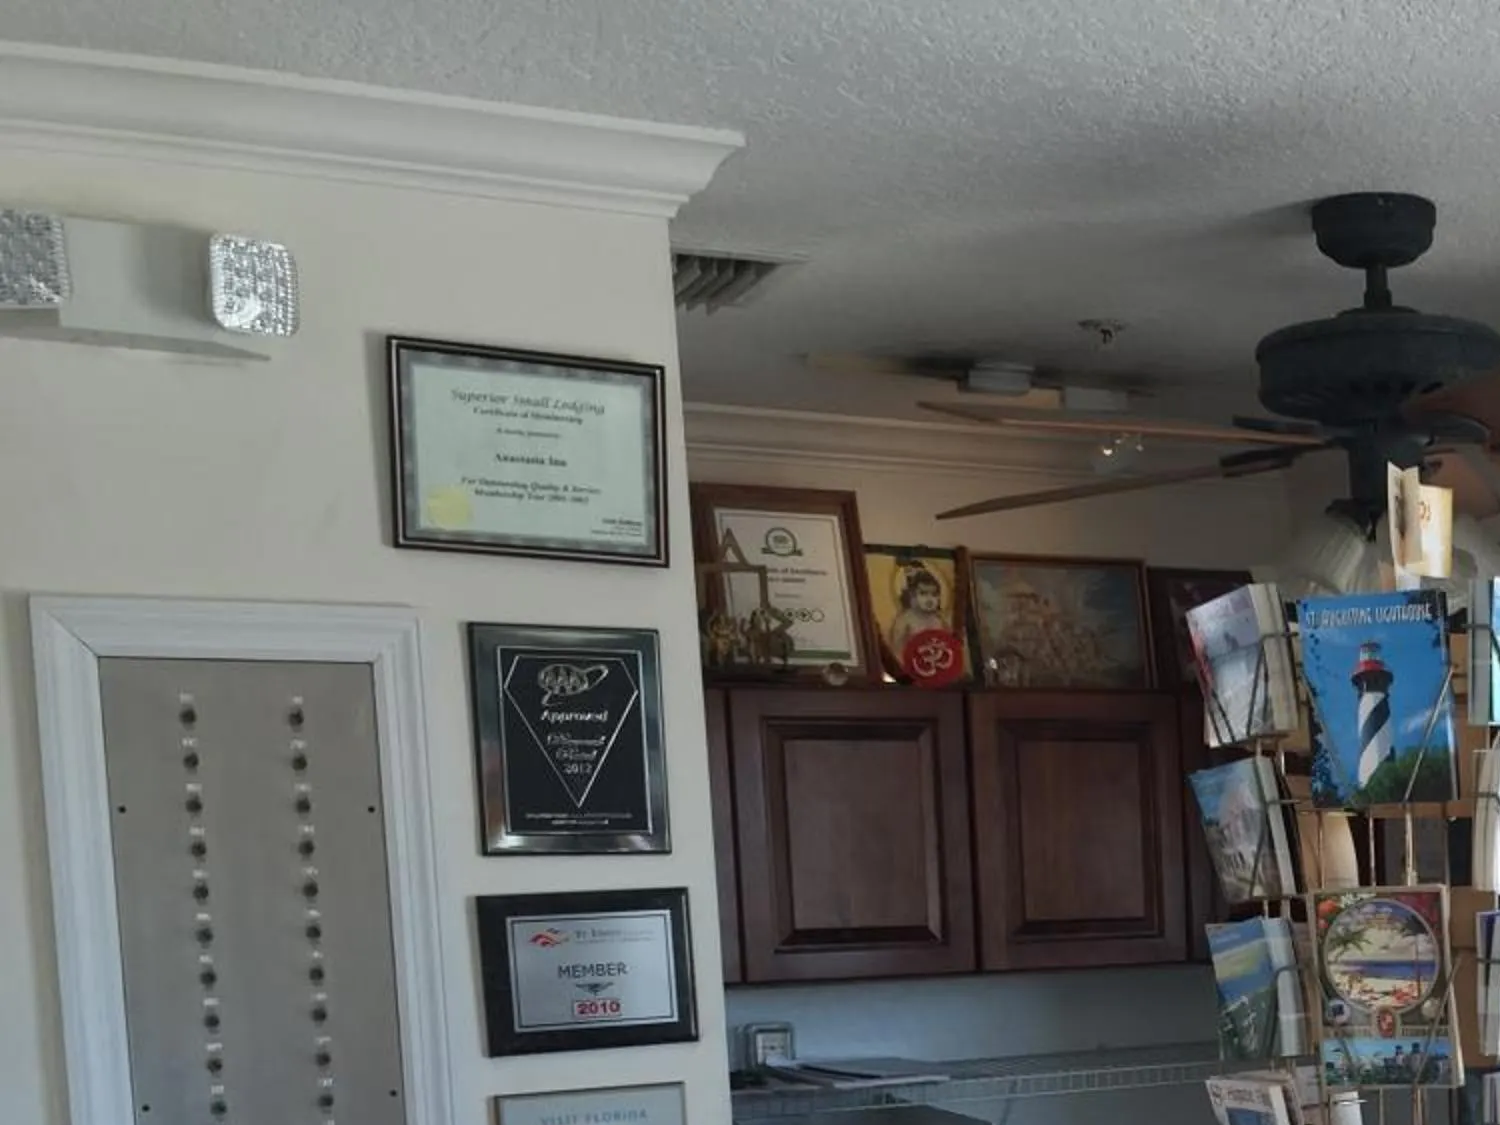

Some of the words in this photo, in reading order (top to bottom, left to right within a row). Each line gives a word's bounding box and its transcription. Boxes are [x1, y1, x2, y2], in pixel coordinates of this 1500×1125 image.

[552, 399, 605, 416] Lodging
[541, 709, 609, 724] Approved
[557, 961, 629, 980] MEMBER
[576, 1000, 622, 1016] 2010
[584, 1108, 649, 1125] FLORIDA
